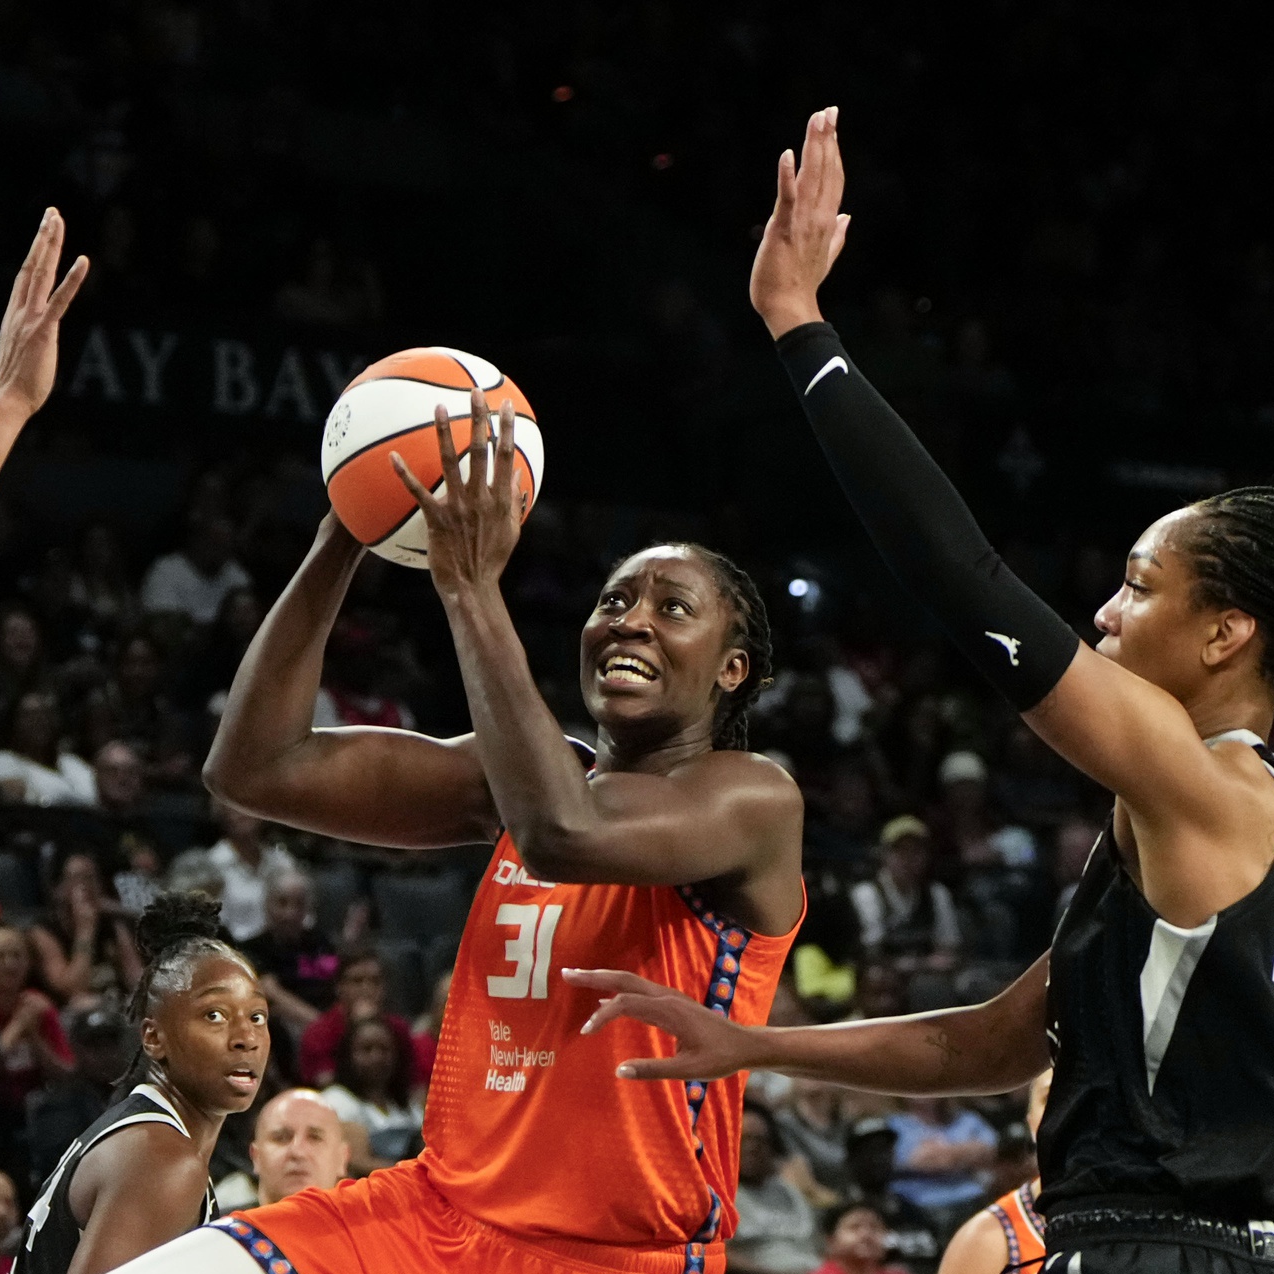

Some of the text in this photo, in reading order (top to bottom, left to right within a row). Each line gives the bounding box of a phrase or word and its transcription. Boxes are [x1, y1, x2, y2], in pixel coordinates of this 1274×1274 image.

[487, 904, 563, 999] 31
[488, 1019, 511, 1042] Yale
[485, 1069, 526, 1092] Health
